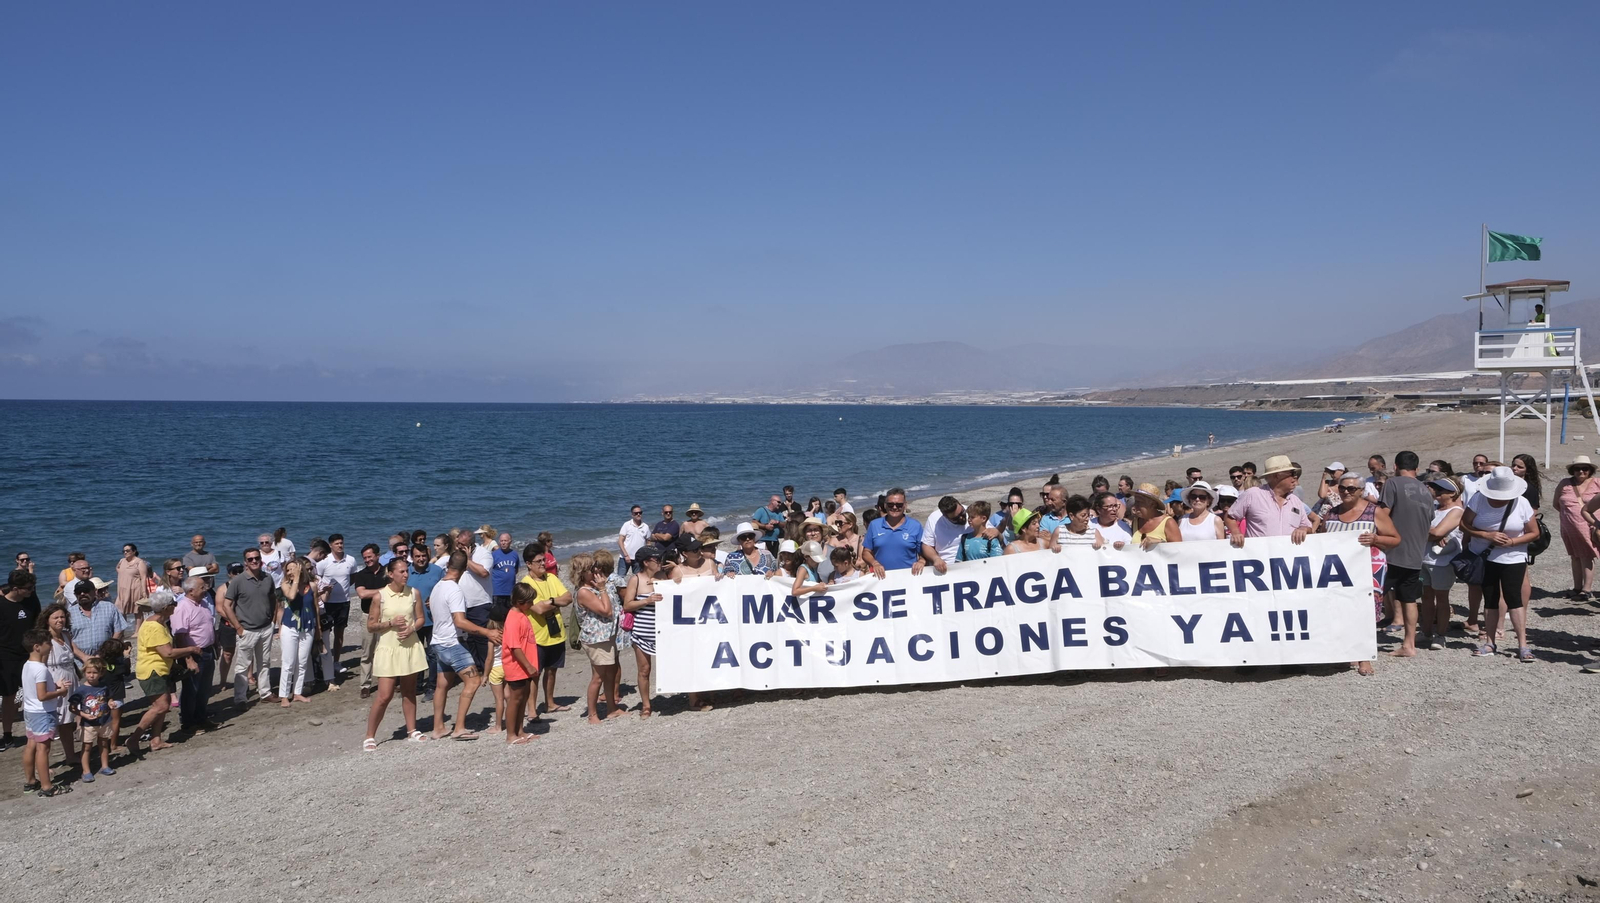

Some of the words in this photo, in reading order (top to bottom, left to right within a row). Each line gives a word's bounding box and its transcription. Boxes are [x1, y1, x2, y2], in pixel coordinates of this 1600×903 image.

[673, 594, 728, 625] LA
[743, 594, 838, 625] MAR
[853, 588, 908, 621] SE
[922, 567, 1083, 615] TRAGA
[1099, 555, 1354, 598] BALERMA
[711, 615, 1129, 669] ACTUACIONES
